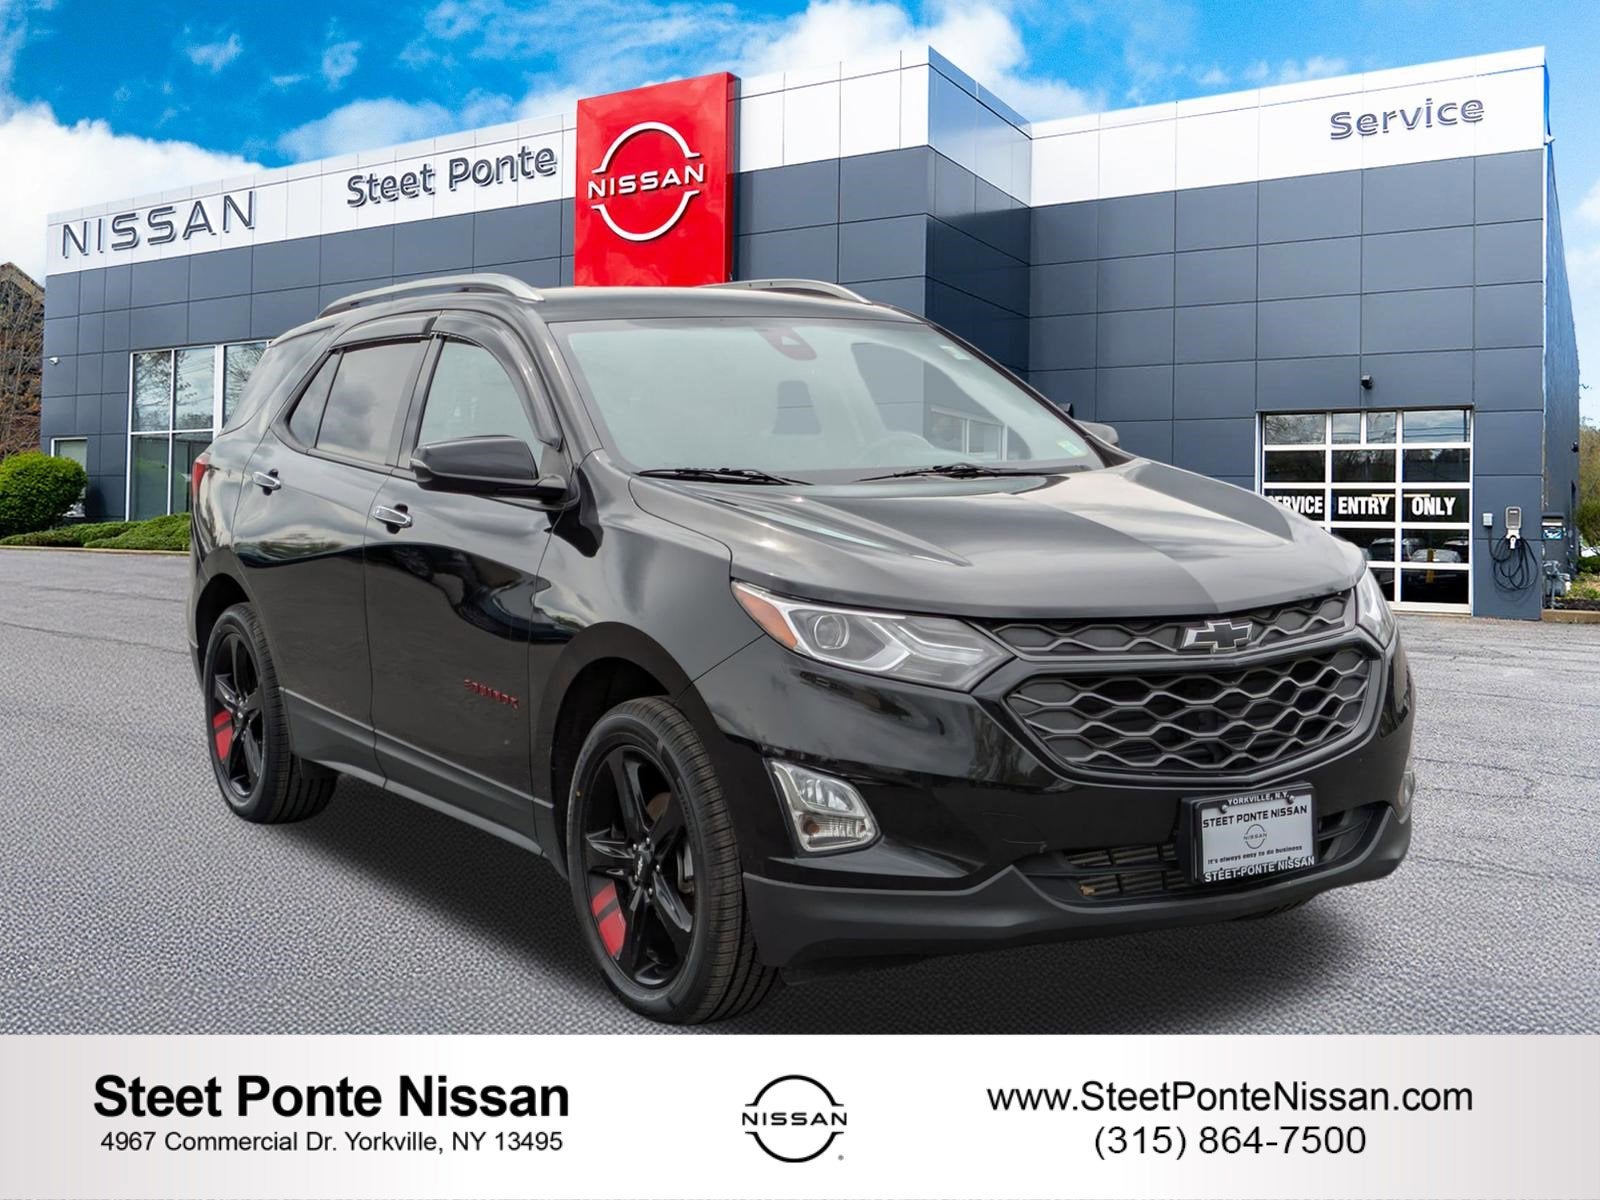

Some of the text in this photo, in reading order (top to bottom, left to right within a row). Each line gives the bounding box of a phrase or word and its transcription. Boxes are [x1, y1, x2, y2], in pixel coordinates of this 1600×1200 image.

[1330, 98, 1484, 140] Service
[346, 146, 557, 207] Steet Ponte
[586, 163, 706, 201] NISSAN
[62, 190, 256, 259] NISSAN
[1338, 495, 1389, 515] ENTRY
[1411, 496, 1456, 516] ONLY
[1203, 805, 1308, 828] STEET PONTE NISSAN
[1205, 855, 1315, 883] STEET-PONTE NISSAN
